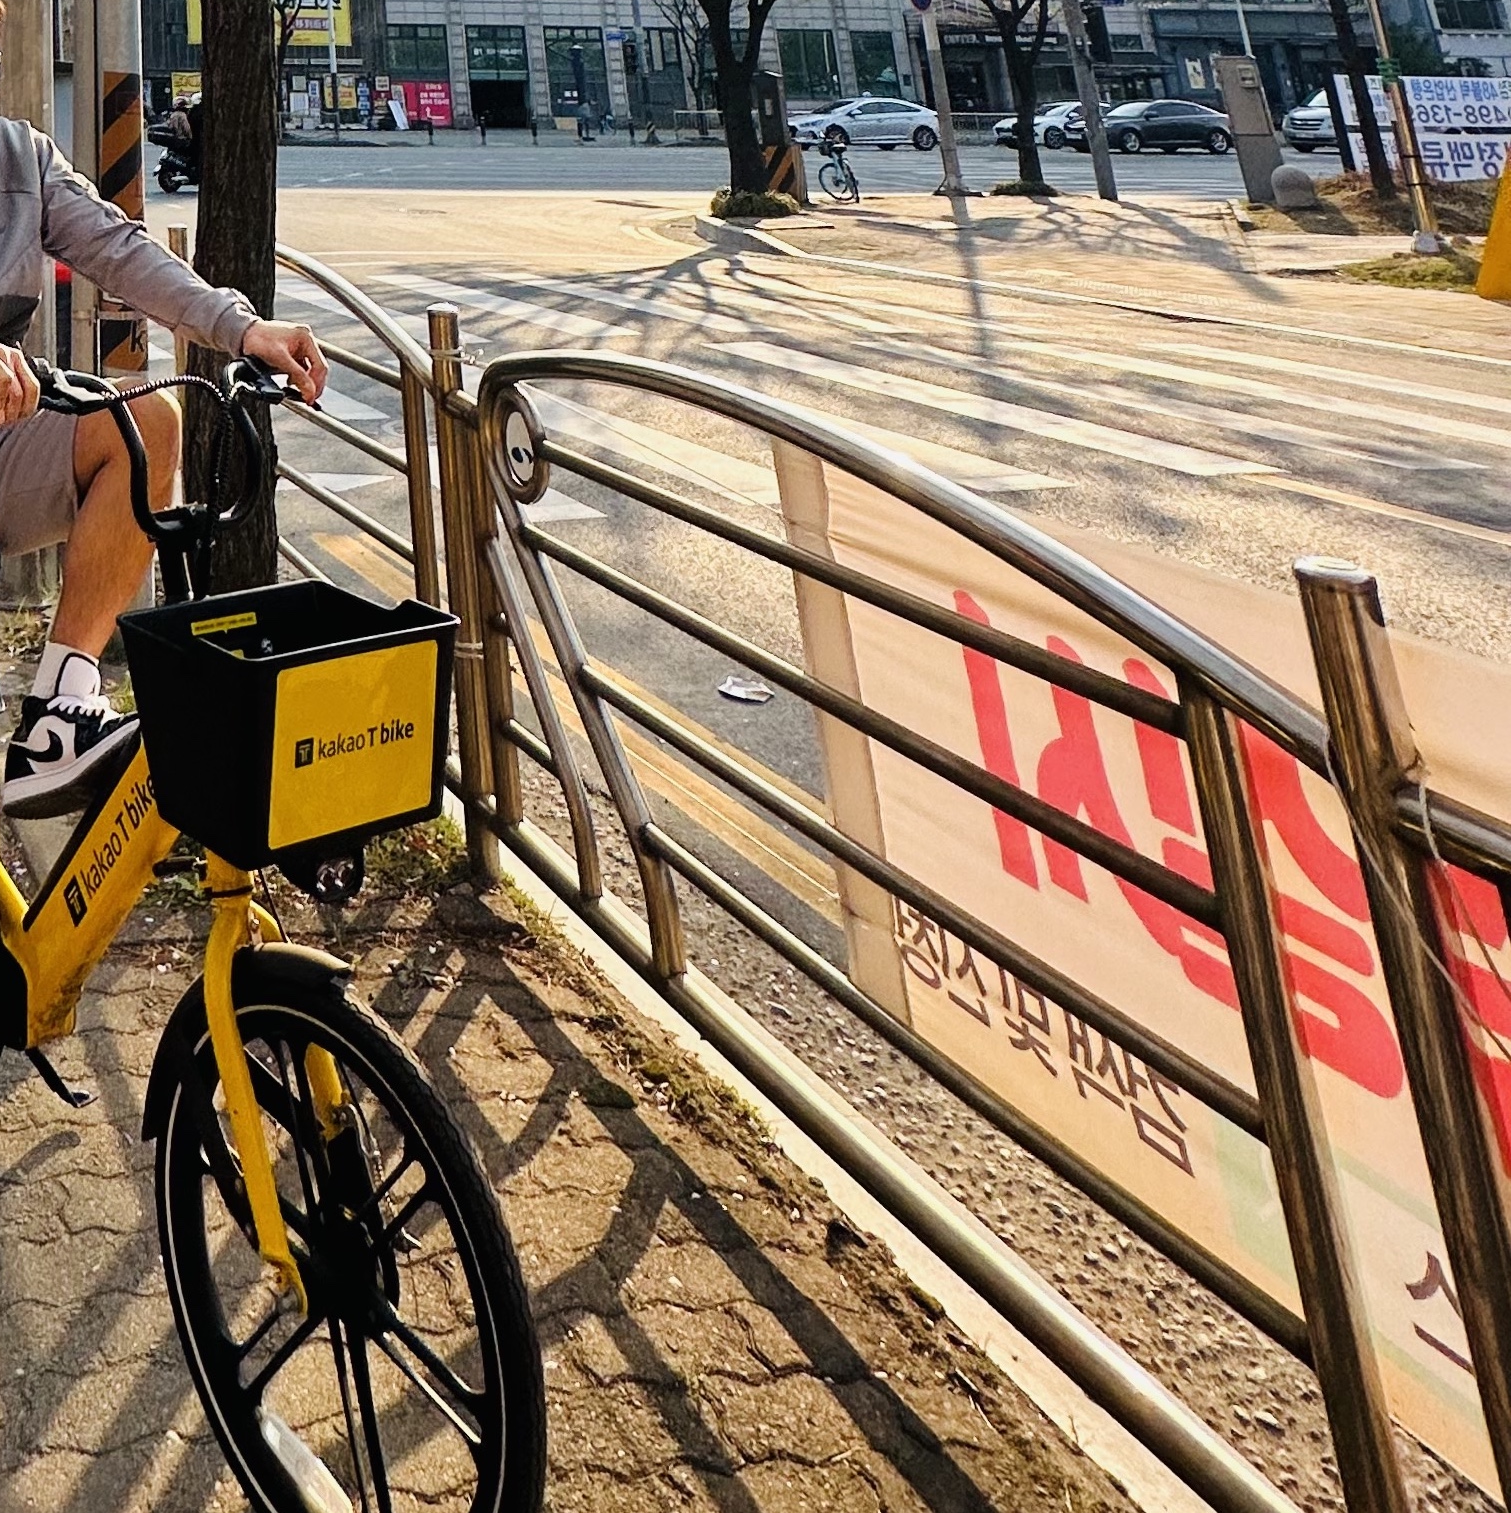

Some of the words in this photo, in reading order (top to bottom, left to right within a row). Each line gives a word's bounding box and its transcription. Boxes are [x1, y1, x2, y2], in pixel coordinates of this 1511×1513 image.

[318, 733, 365, 760] kakao
[380, 718, 415, 745] bike
[80, 832, 123, 900] kakao
